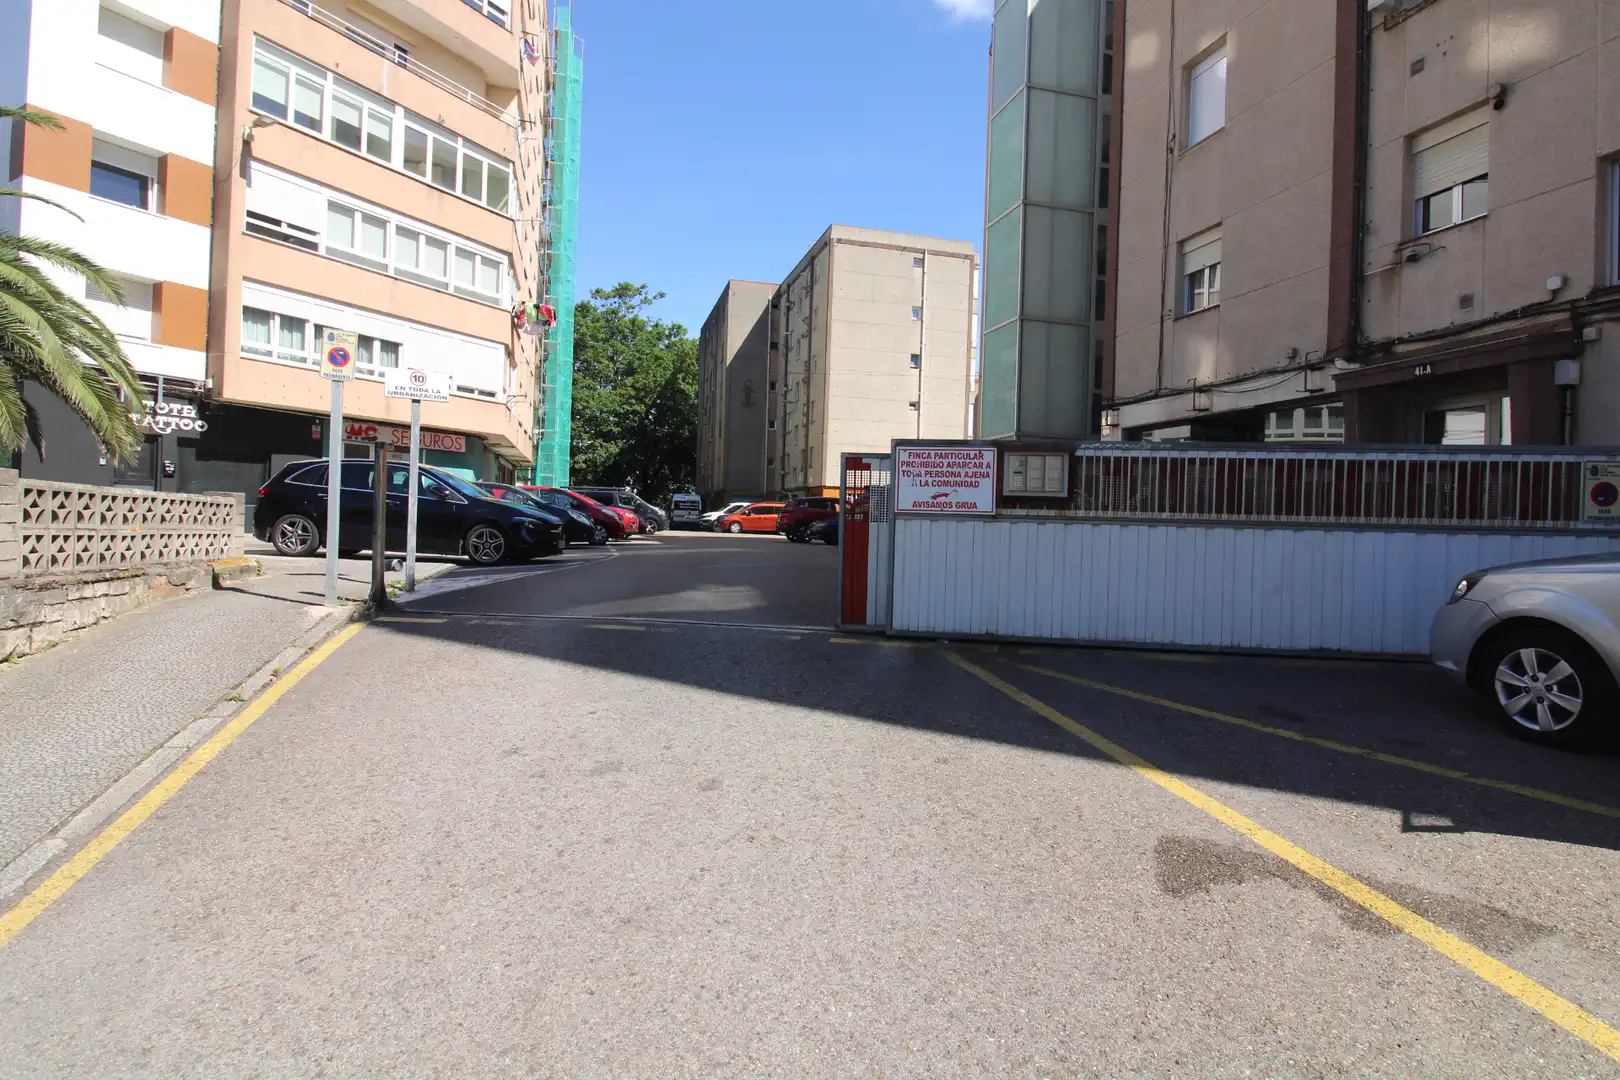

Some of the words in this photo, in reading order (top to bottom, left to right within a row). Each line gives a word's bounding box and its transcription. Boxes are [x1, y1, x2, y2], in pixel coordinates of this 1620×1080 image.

[412, 374, 424, 383] 10
[391, 429, 463, 450] SEUROS
[908, 452, 932, 460] FINCA
[934, 452, 984, 460] PARTICULAR
[900, 460, 944, 469] PROHIBIDO
[946, 461, 984, 469] APARCAR
[924, 470, 962, 478] PERSONA
[964, 470, 990, 478] AJENA
[920, 479, 930, 488] LA
[931, 480, 980, 488] COMUNIDAD
[912, 501, 953, 509] AVISAMOS
